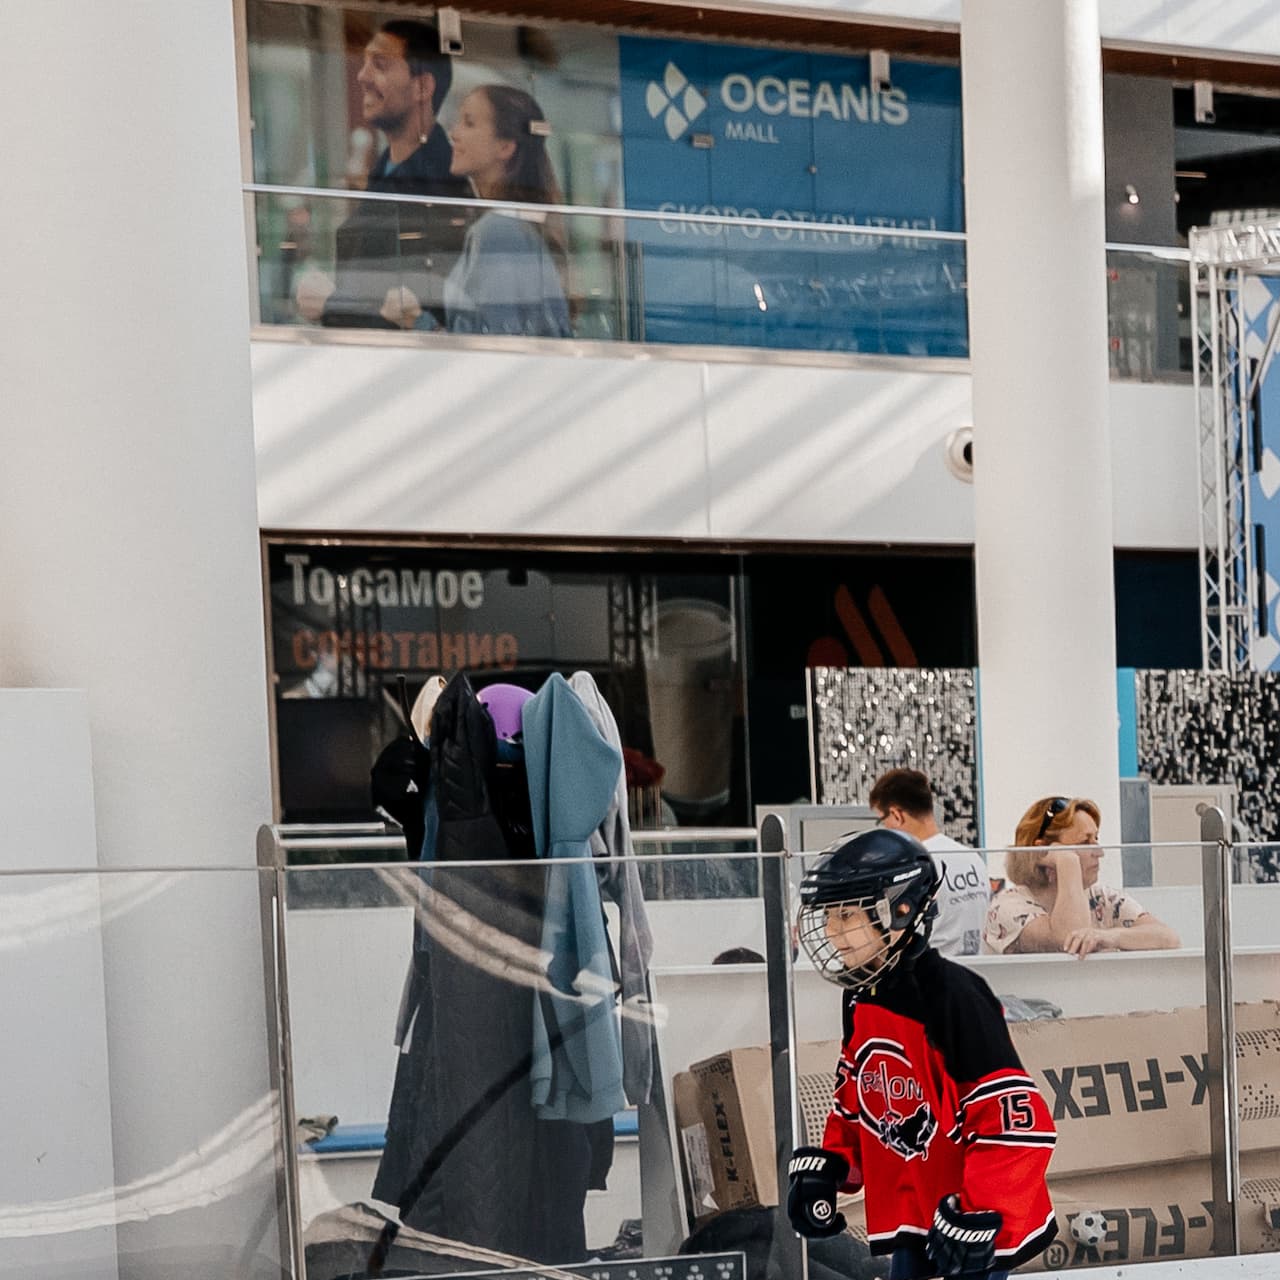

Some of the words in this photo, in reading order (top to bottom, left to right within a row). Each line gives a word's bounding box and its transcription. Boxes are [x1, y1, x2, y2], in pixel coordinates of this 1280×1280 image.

[720, 73, 909, 126] OCEANIS
[725, 121, 780, 144] MALL
[351, 566, 485, 609] самое
[1042, 1052, 1210, 1121] K-FLEX
[998, 1092, 1035, 1134] 15
[713, 1102, 740, 1183] K-FLEX
